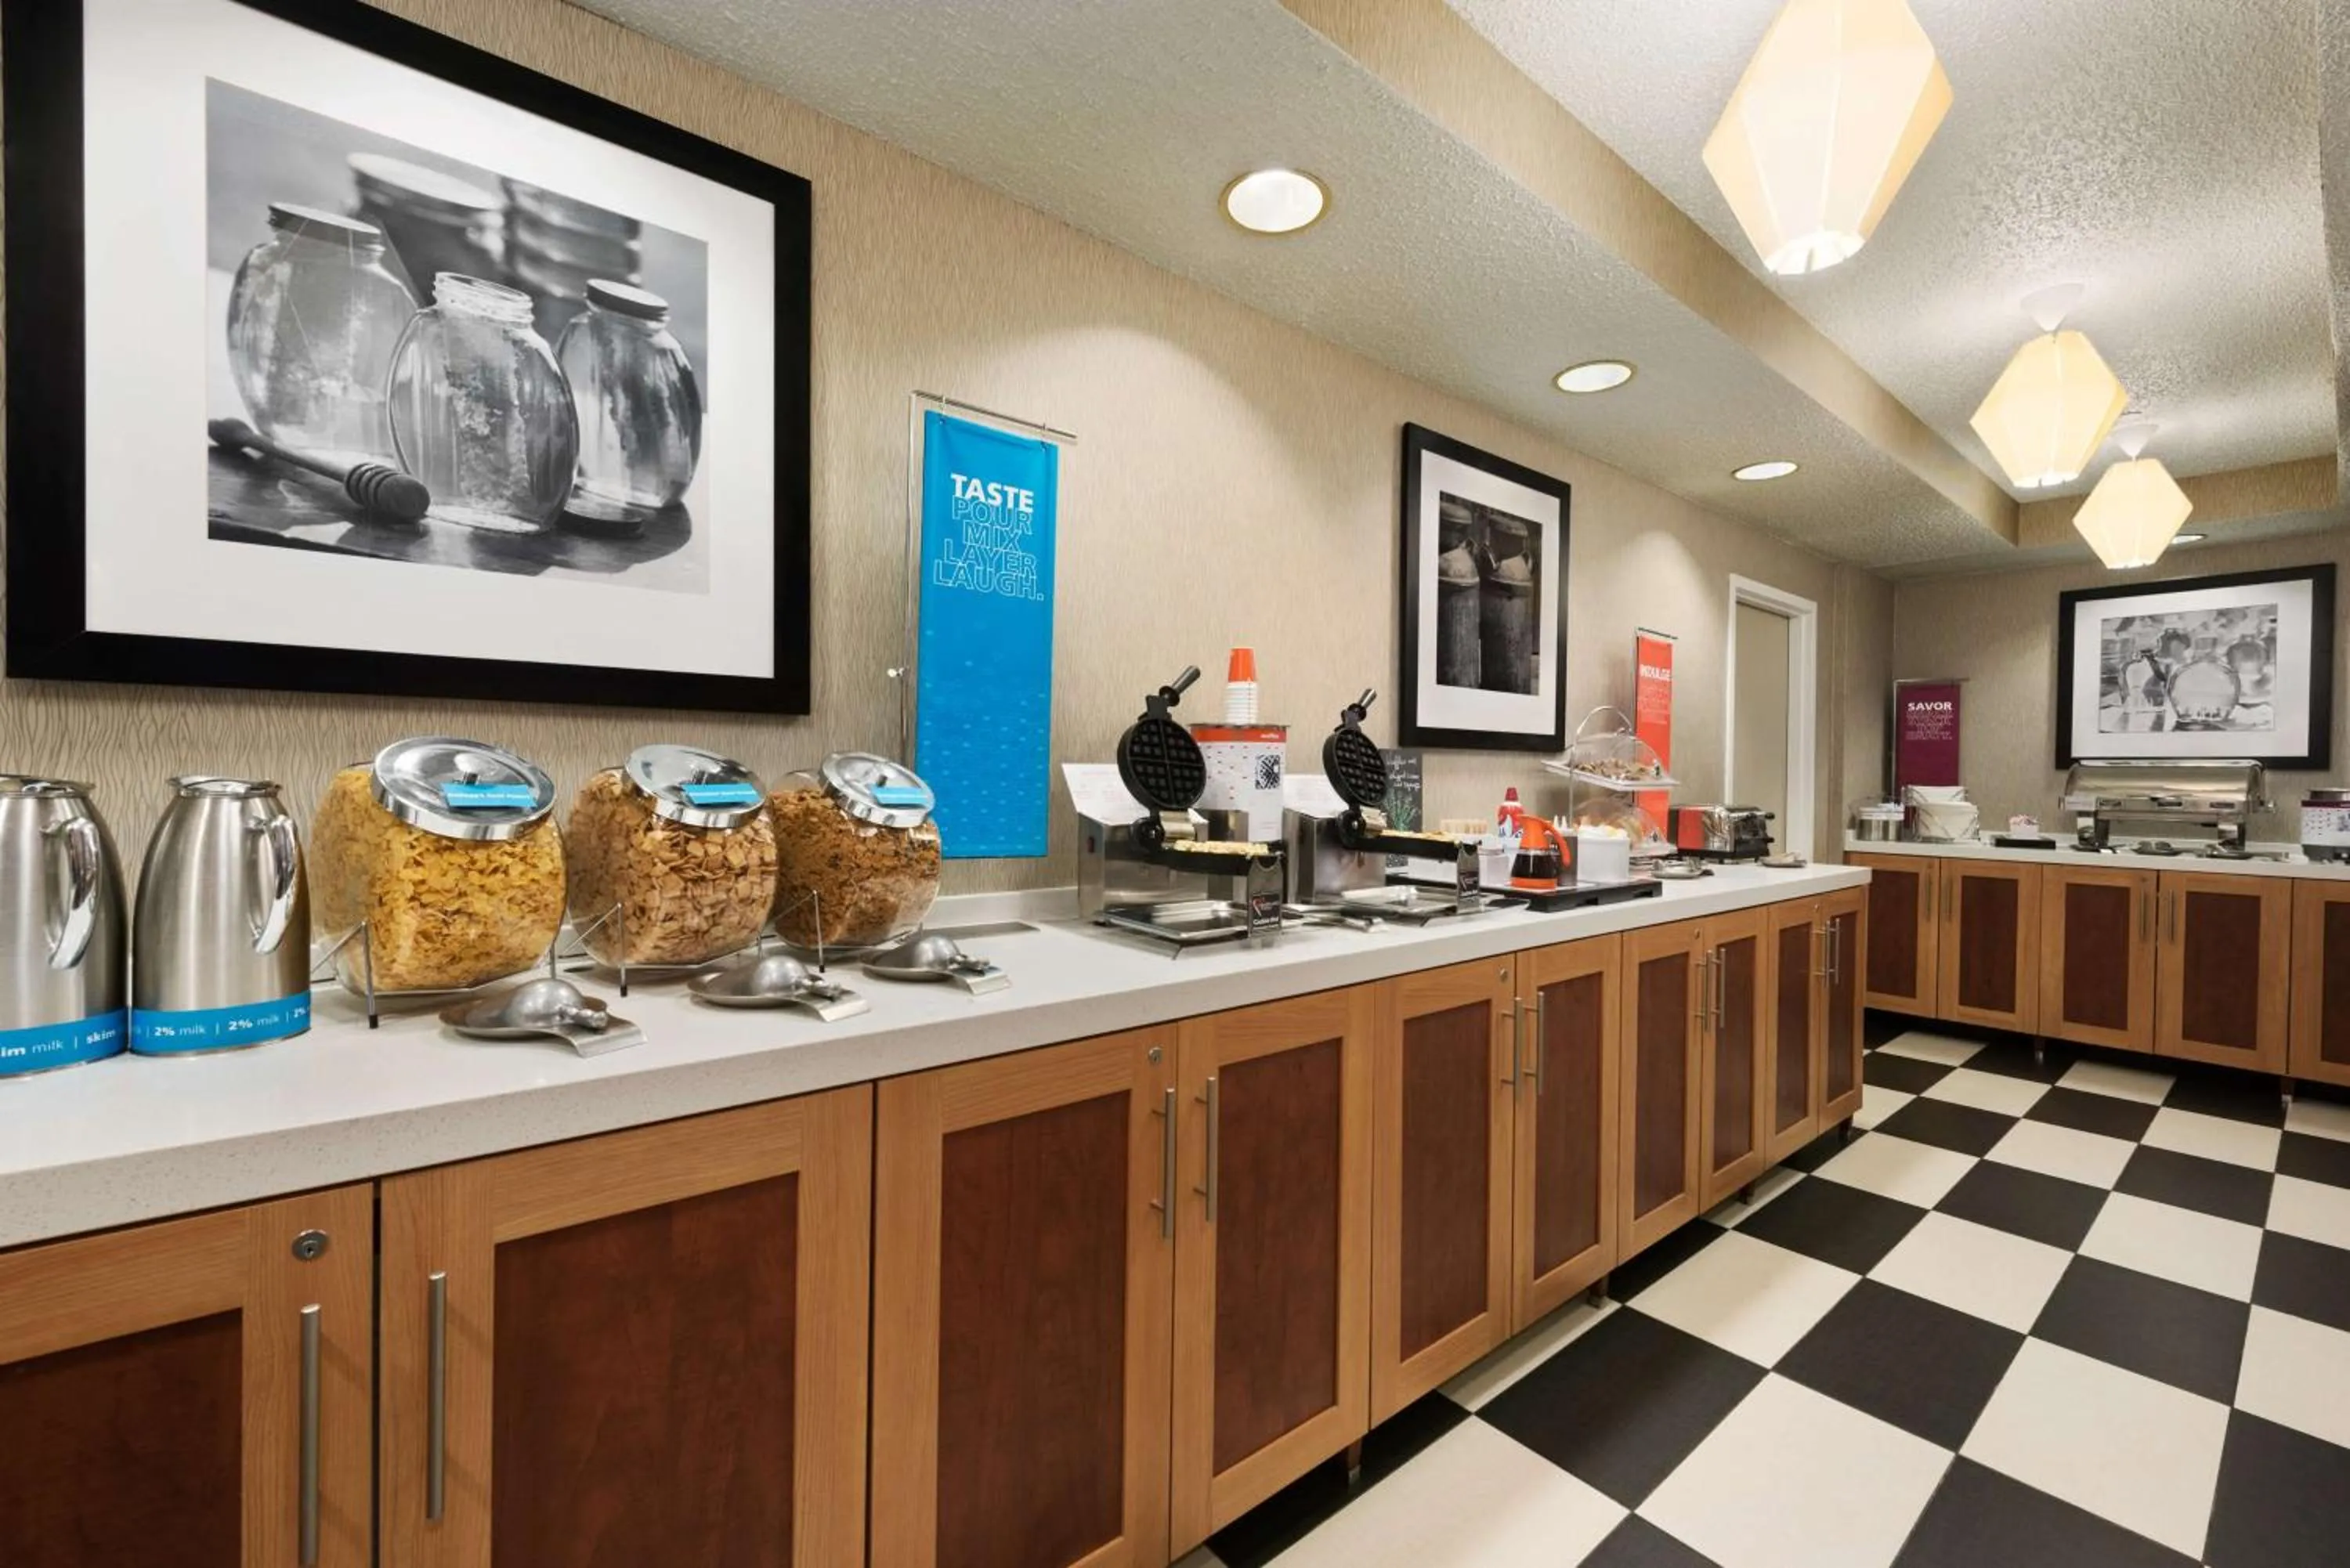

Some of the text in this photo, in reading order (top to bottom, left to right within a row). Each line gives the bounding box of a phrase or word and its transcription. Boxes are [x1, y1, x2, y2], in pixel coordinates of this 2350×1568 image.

[950, 473, 1034, 513] TASTE
[952, 496, 1032, 535] POUR
[963, 520, 1021, 551] MIX
[944, 538, 1037, 578] LAYER
[933, 559, 1044, 601] LAUGH.
[1907, 702, 1952, 711] SAVOR
[154, 1027, 175, 1036] 2%
[179, 1025, 206, 1036] milk
[228, 1019, 253, 1031] 2%
[257, 1013, 280, 1027] milk
[0, 1029, 116, 1057] im milk skim
